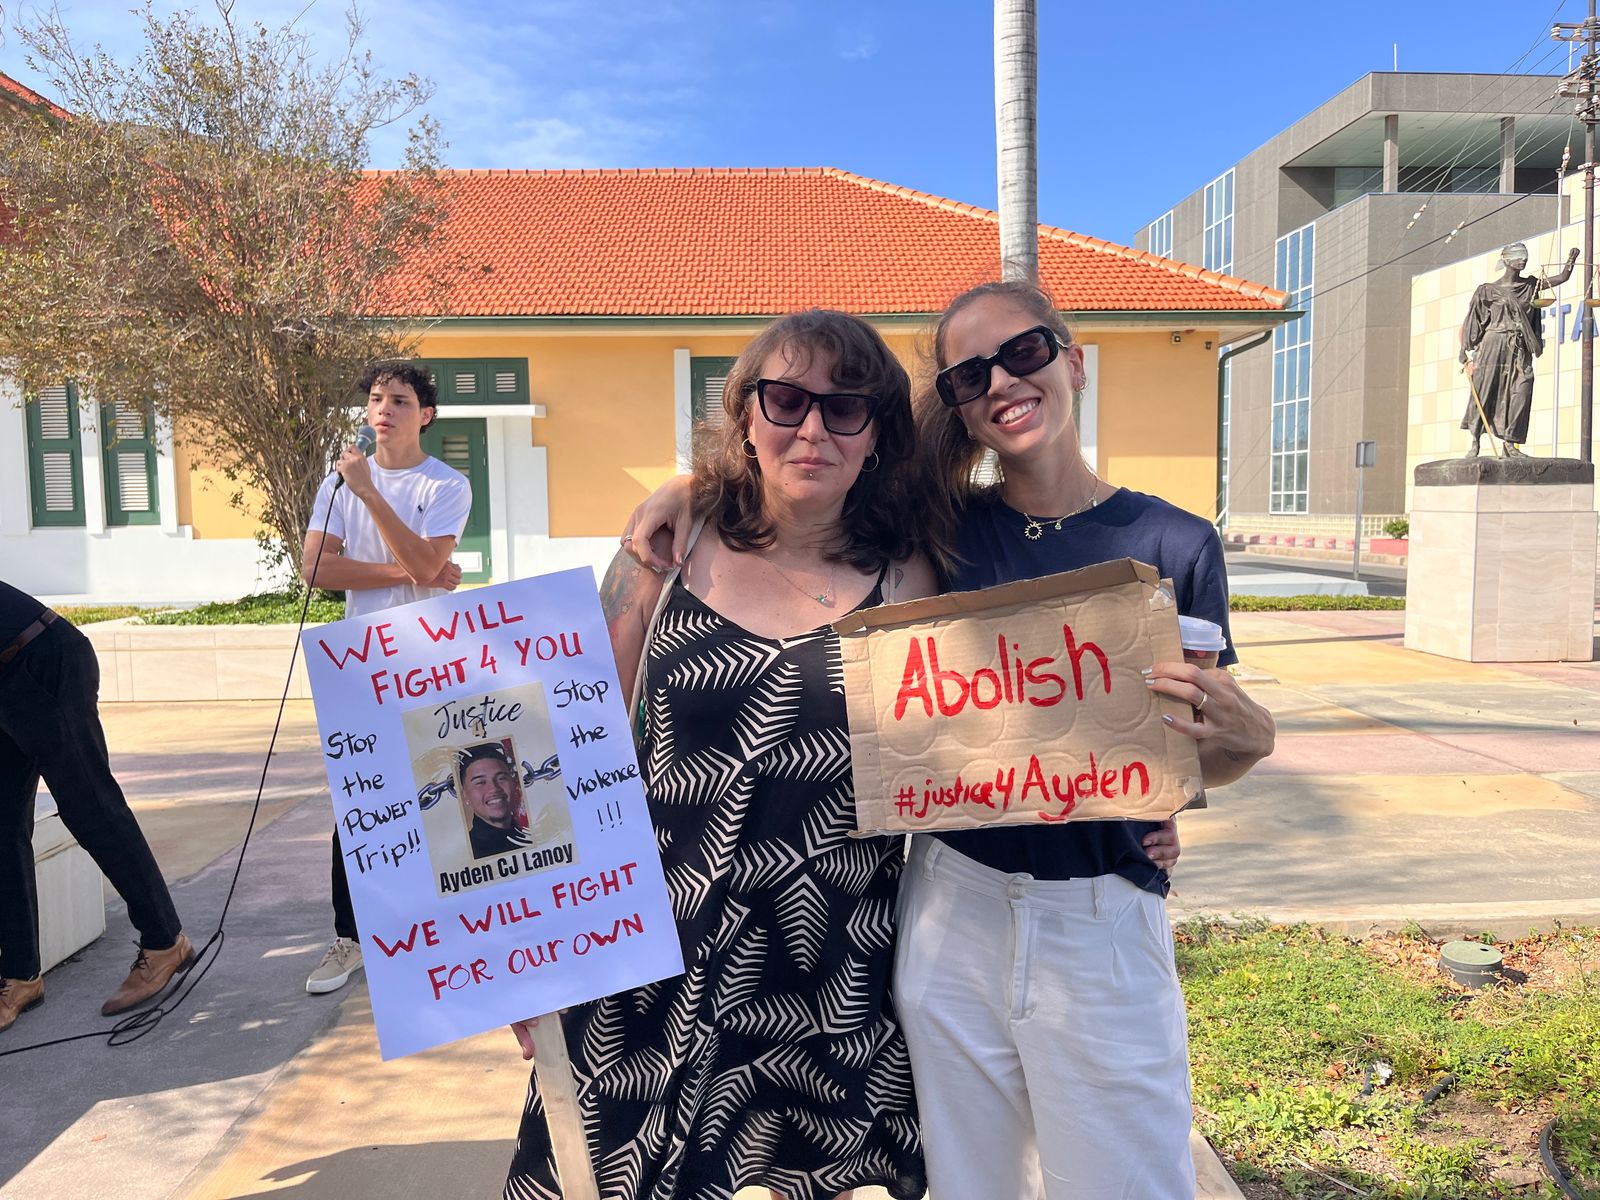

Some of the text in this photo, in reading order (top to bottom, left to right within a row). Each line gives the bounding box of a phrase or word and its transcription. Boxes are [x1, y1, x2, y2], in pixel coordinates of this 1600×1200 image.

[319, 601, 524, 670] WE WILL
[371, 631, 584, 706] FIGHT 4 YOU
[894, 624, 1111, 721] Abolish
[553, 679, 609, 708] Stop
[434, 696, 524, 739] Justice
[569, 724, 609, 748] the
[326, 731, 377, 760] Stop
[342, 771, 385, 798] the
[597, 800, 623, 832] !!!
[345, 828, 421, 875] Trip!!
[440, 843, 574, 893] Ayden CJ Lanoy
[372, 862, 638, 958] WE WILL FIGHT
[427, 957, 494, 1001] FOR
[573, 912, 645, 956] OWN
